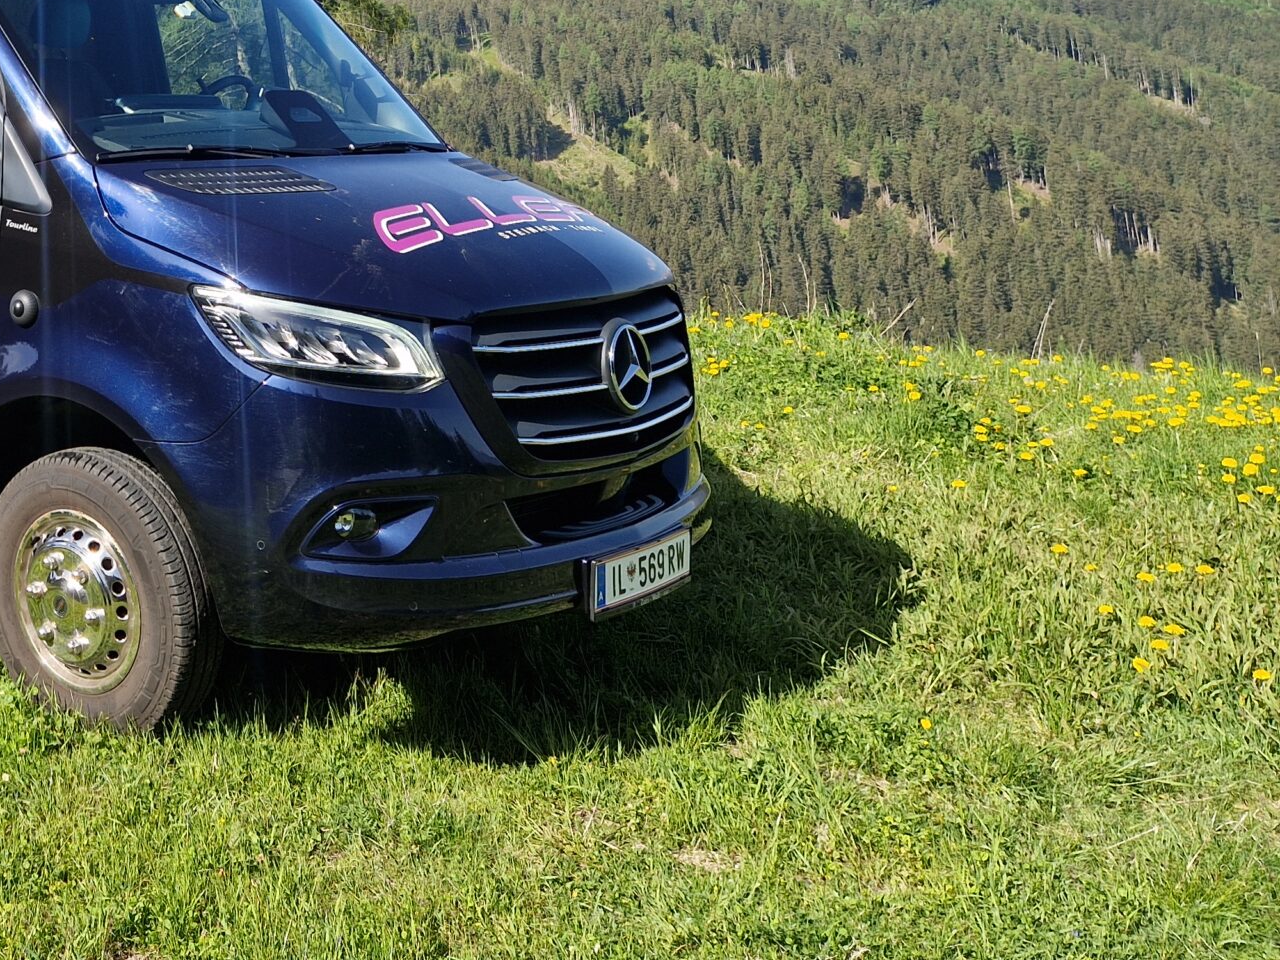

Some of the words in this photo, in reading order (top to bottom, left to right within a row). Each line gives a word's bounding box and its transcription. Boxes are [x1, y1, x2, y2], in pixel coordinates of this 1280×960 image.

[6, 219, 38, 233] Tourline
[498, 224, 560, 239] STEINACH
[612, 563, 627, 598] IL
